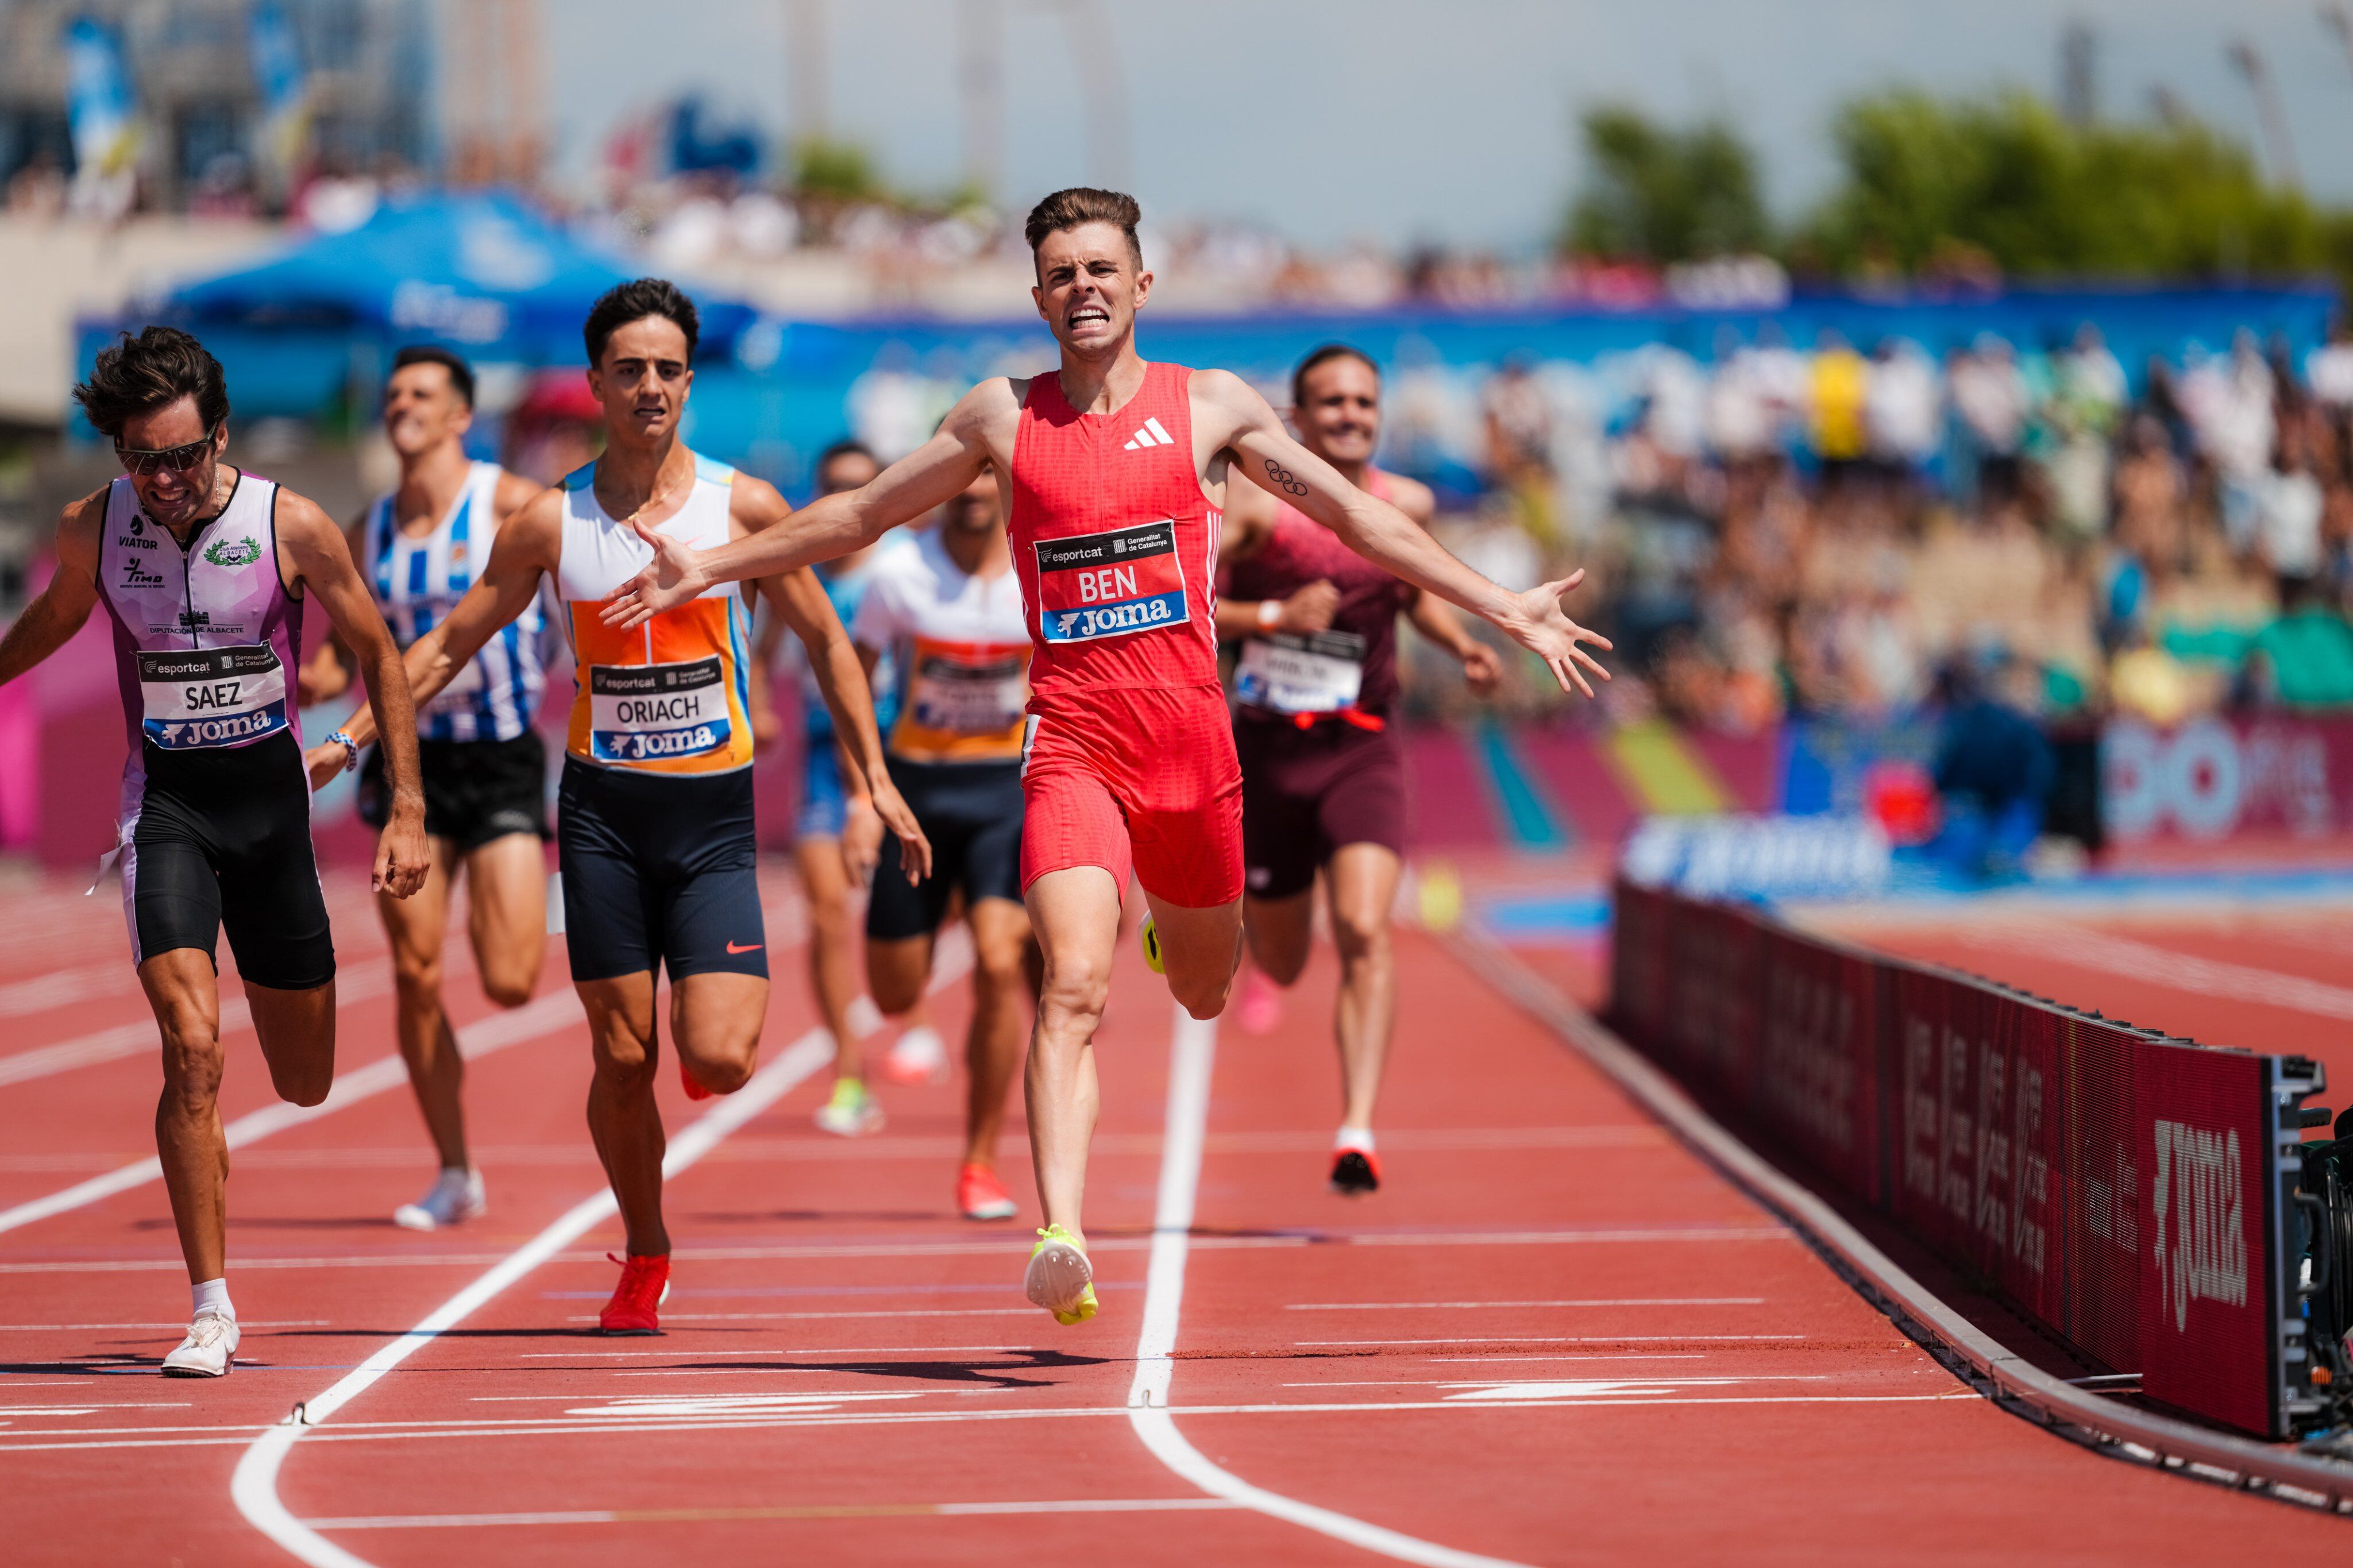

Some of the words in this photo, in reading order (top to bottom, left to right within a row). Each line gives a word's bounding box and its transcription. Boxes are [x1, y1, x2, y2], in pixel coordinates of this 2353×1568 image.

[119, 536, 157, 550] VIATOR
[1128, 533, 1160, 544] Generalitat
[1138, 539, 1167, 550] Catalunya
[1052, 547, 1102, 563] esportcat
[1078, 565, 1137, 603] BEN
[235, 652, 269, 661] Generalitat
[245, 656, 273, 666] Catalunya
[157, 662, 210, 675] esportcat
[606, 677, 656, 690] esportcat
[186, 682, 242, 710] SAEZ
[617, 696, 699, 724] ORIACH
